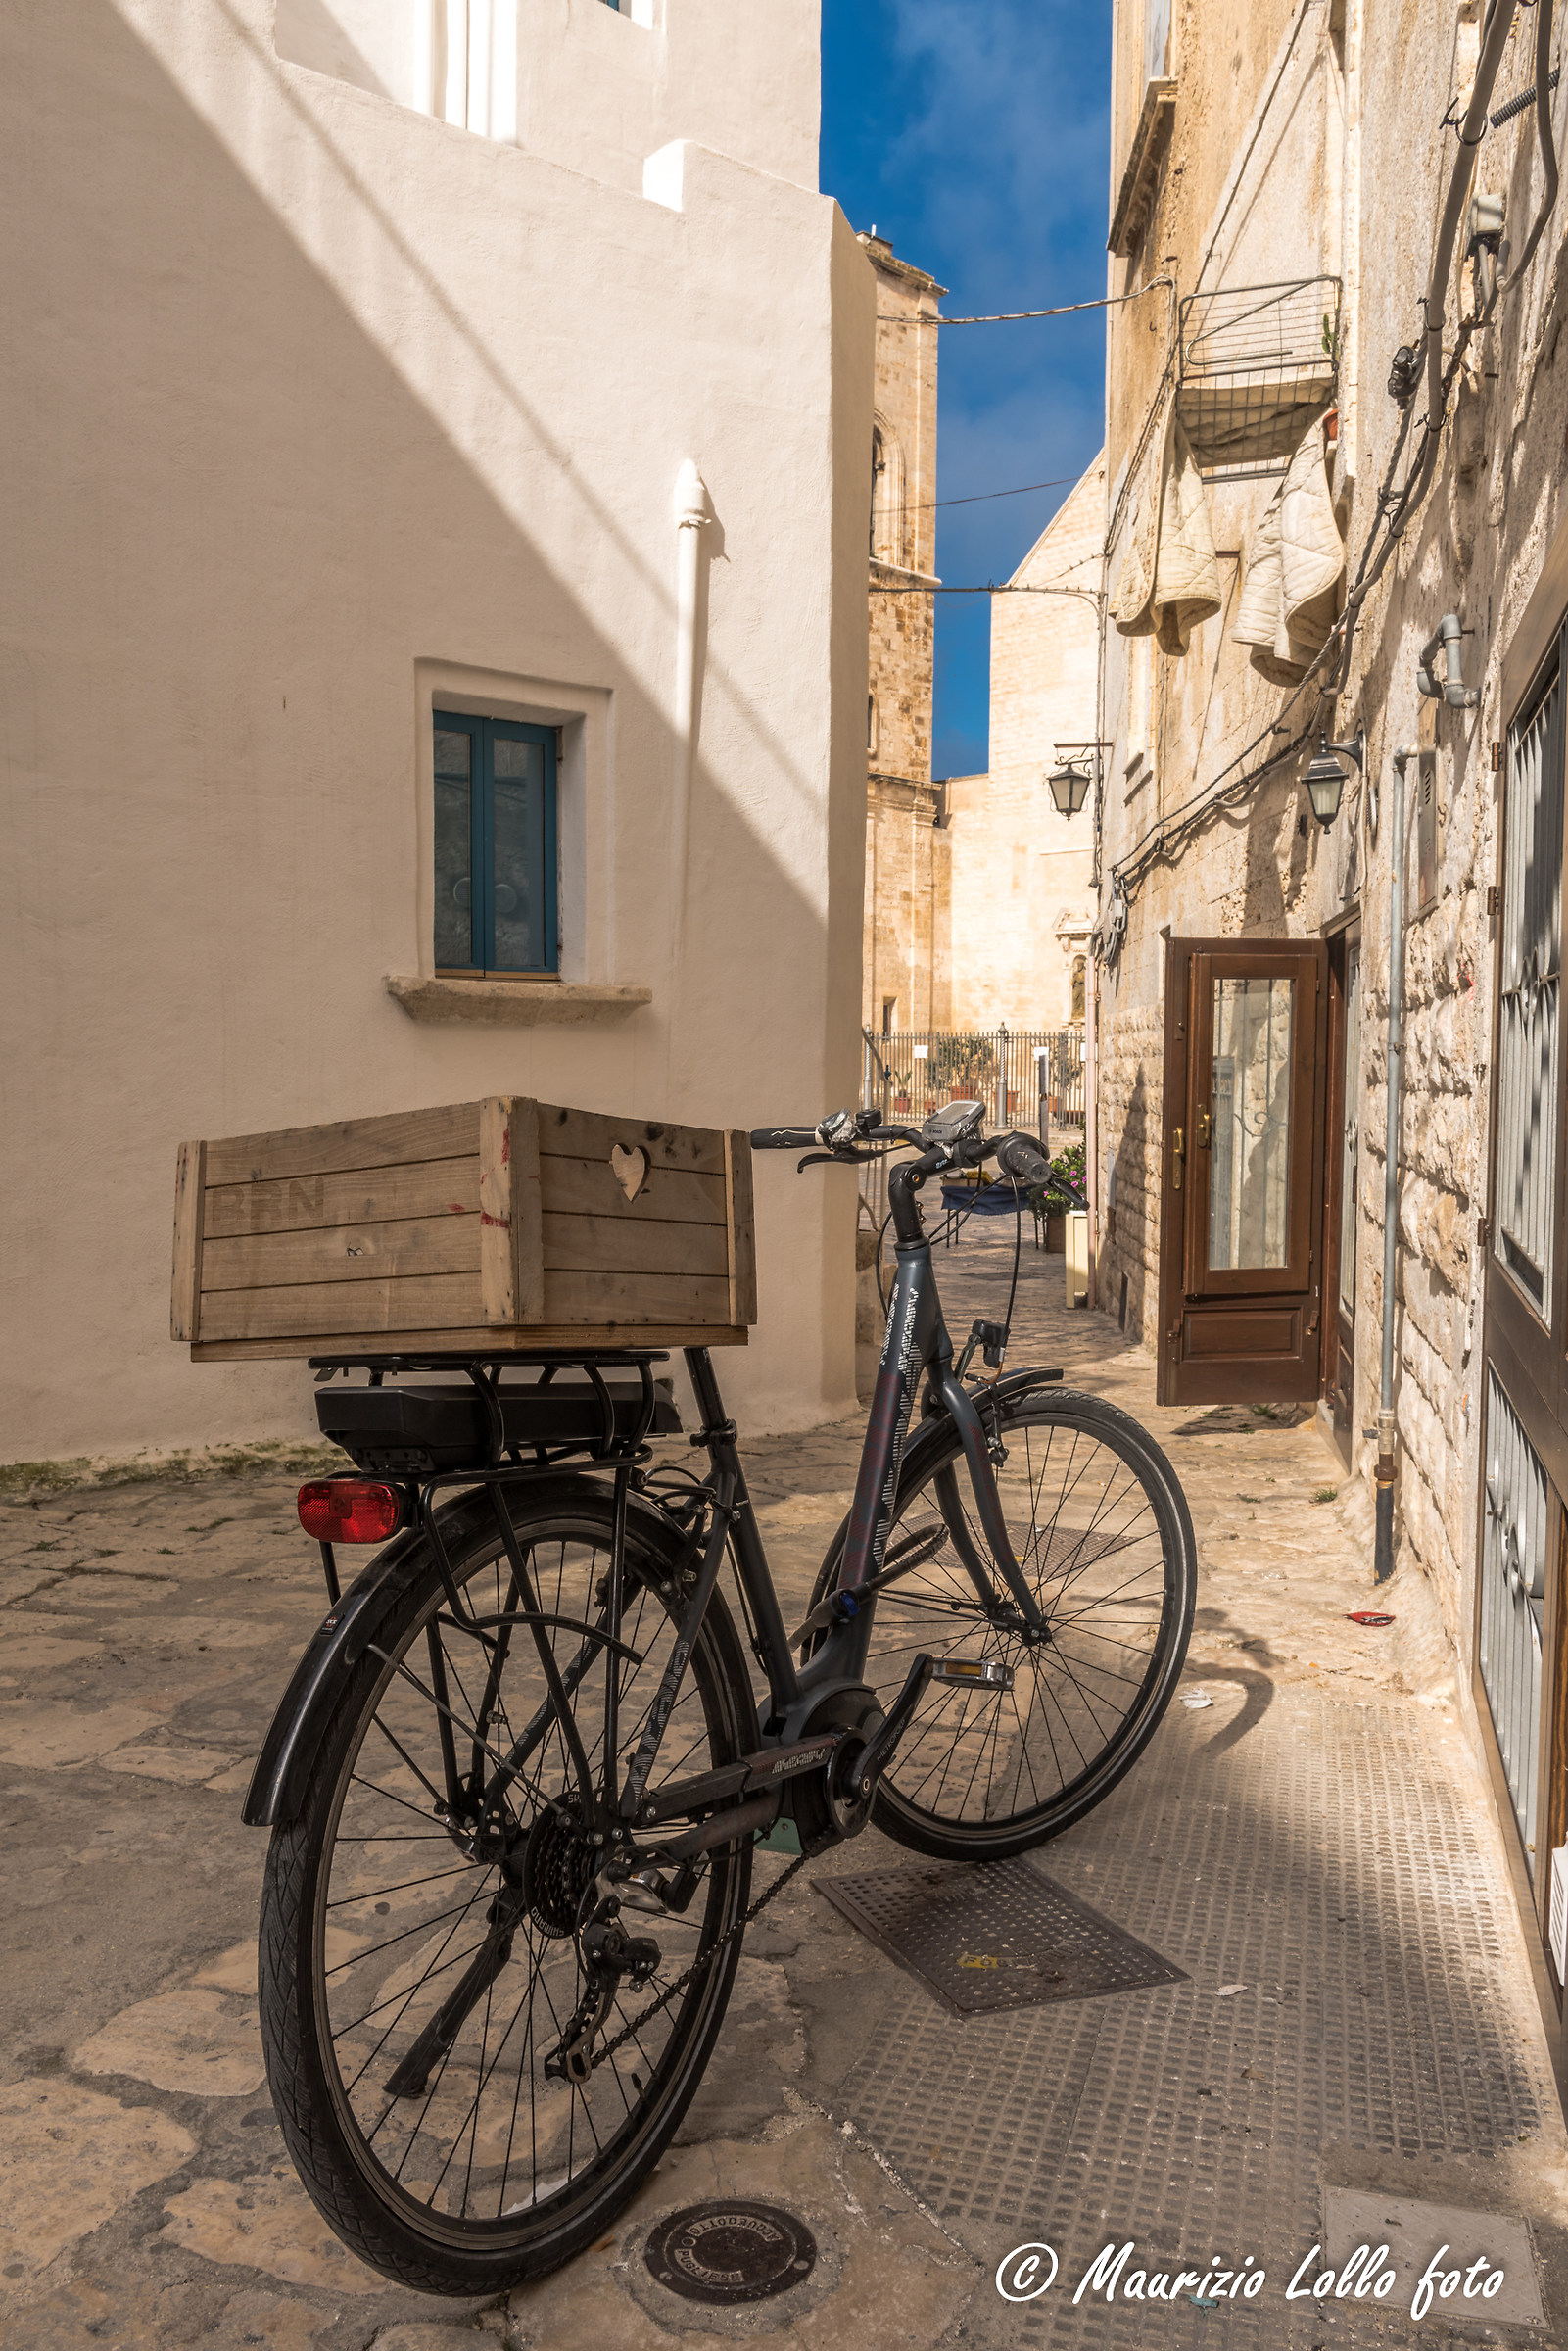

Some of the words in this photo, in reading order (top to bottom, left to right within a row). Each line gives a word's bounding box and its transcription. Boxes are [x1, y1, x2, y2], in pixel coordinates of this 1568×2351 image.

[212, 1176, 324, 1223] BRN
[530, 1906, 565, 1937] SHIMANO
[689, 2217, 781, 2240] ACQUEDOTTO
[677, 2250, 740, 2282] PUGLIESE
